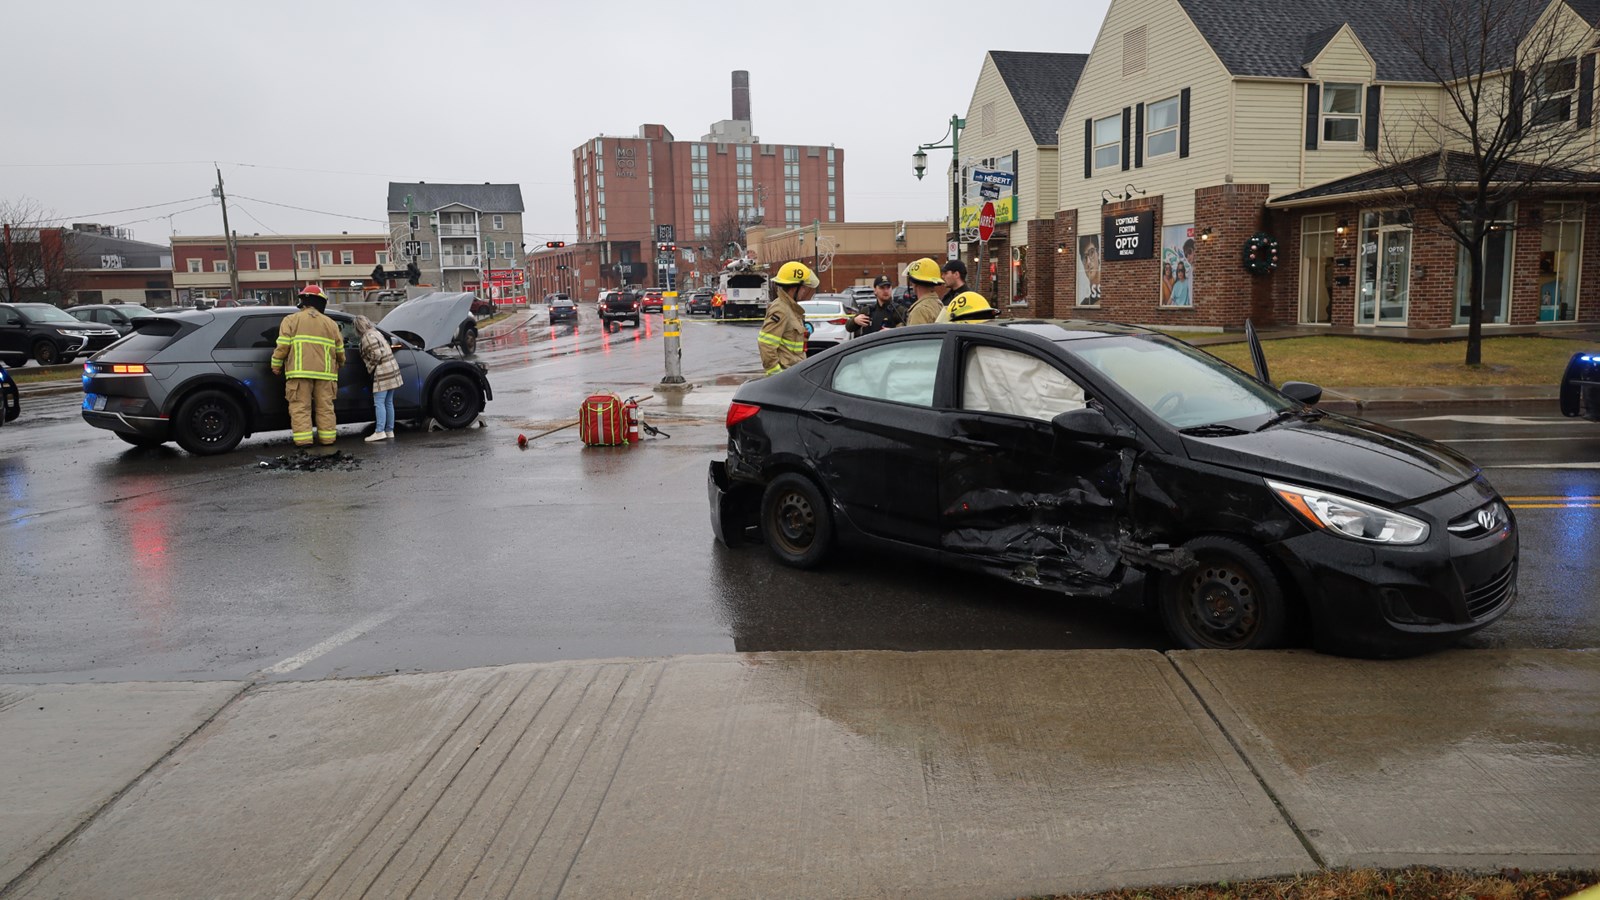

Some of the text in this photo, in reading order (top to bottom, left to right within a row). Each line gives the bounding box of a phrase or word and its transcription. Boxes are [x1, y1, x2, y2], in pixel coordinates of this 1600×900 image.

[984, 174, 1011, 185] HÉBERT
[980, 215, 995, 228] ARRÊT
[1115, 216, 1139, 226] L'OPTIQUE
[1118, 225, 1136, 234] FORTIN
[1115, 236, 1139, 249] OPTO
[1341, 238, 1348, 248] 2
[1119, 248, 1134, 256] RÉSEAU
[793, 269, 804, 279] 19
[950, 296, 967, 312] 29
